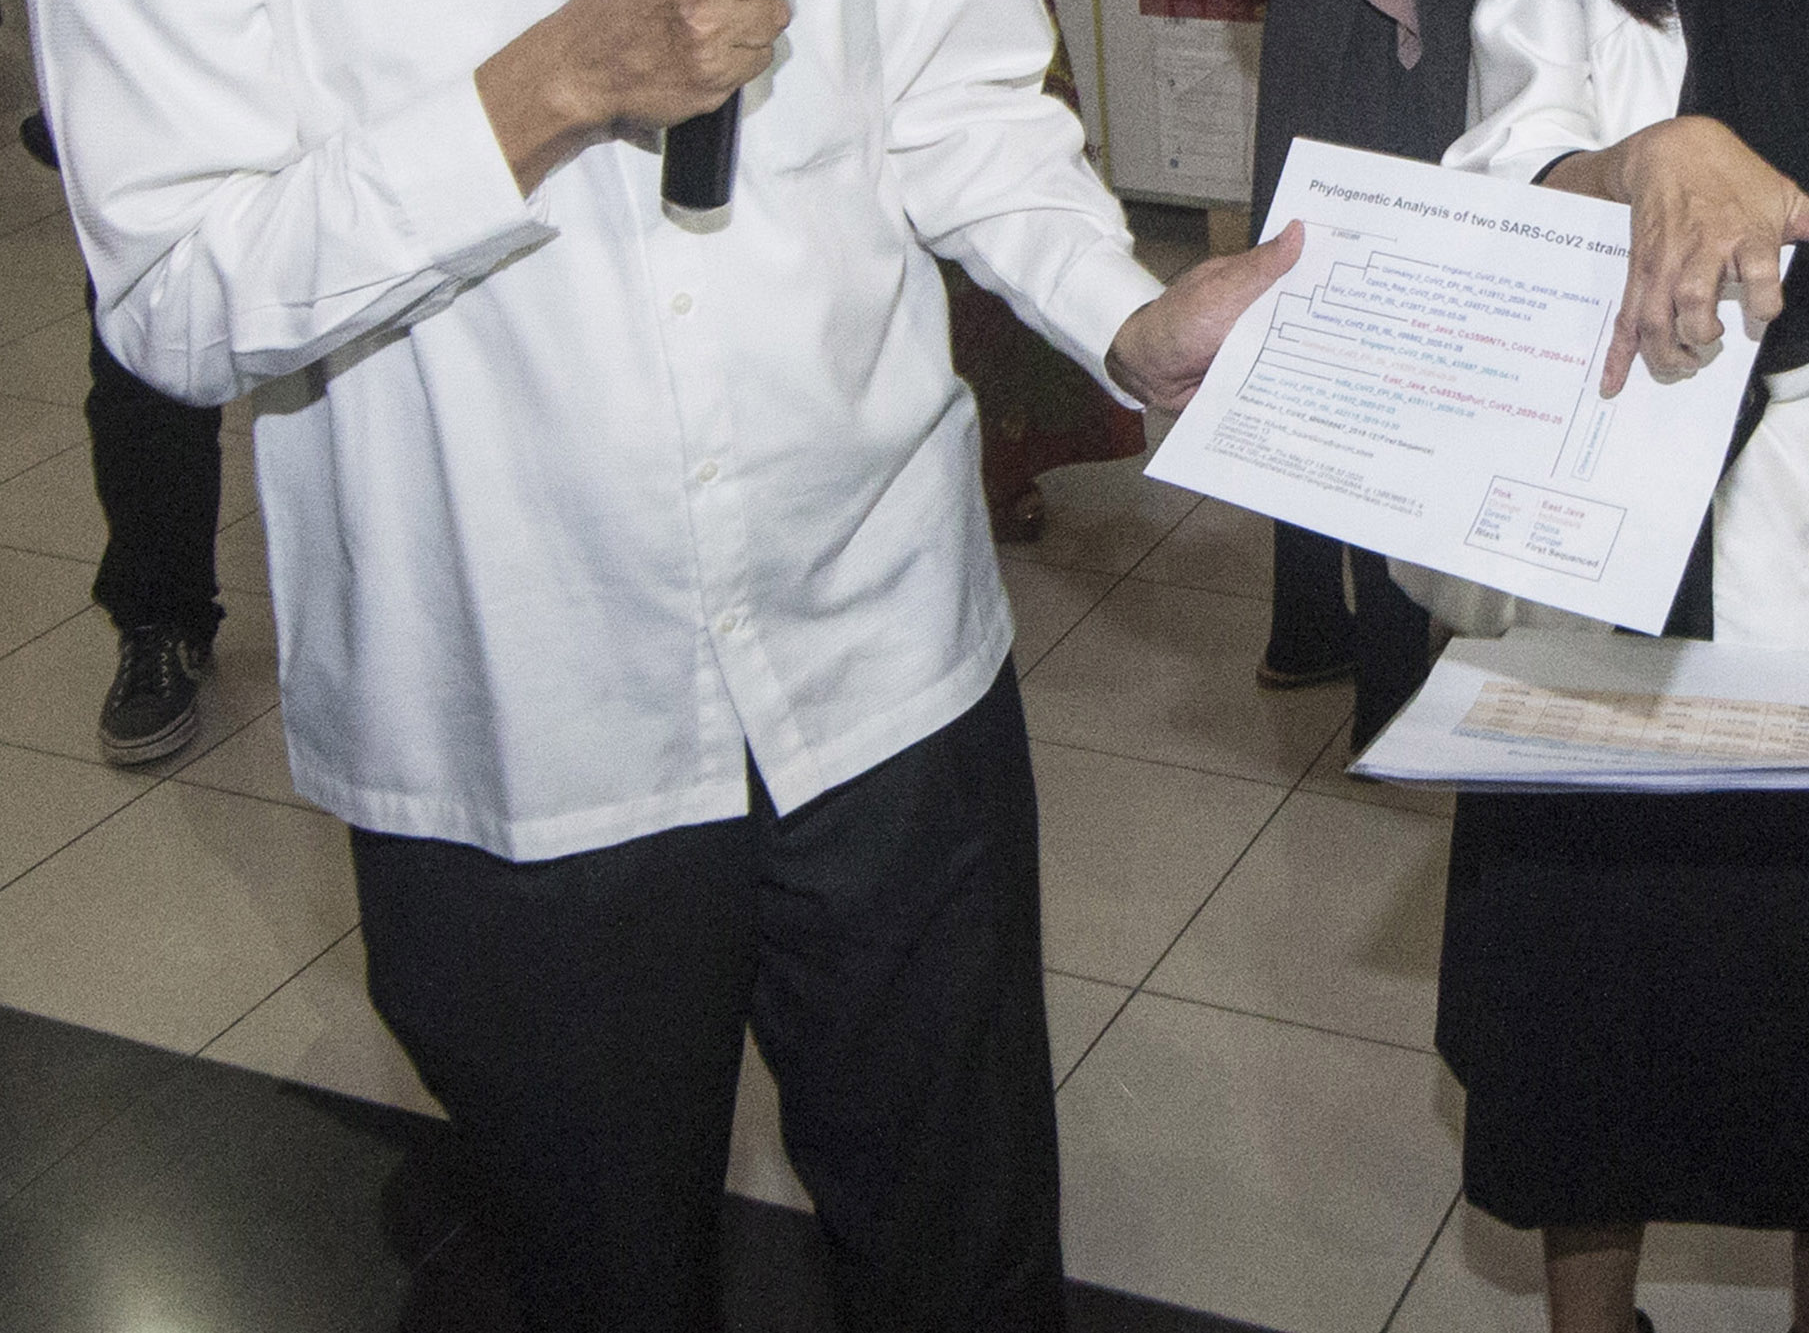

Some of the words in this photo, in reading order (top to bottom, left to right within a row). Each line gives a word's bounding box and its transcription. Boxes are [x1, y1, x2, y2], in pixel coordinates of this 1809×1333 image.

[1309, 179, 1391, 207] Phylogenetic
[1393, 197, 1450, 220] Analysis
[1453, 210, 1468, 223] of
[1471, 215, 1496, 230] two
[1499, 219, 1583, 249] SARS-CoV2
[1493, 487, 1511, 499] Pink
[1563, 506, 1585, 518] Java
[1480, 518, 1500, 529] Blue
[1530, 532, 1562, 547] Europe
[1484, 508, 1511, 522] Green
[1533, 522, 1560, 535] China
[1475, 527, 1500, 541] Black
[1525, 542, 1547, 555] First
[1549, 547, 1599, 569] Sequenced
